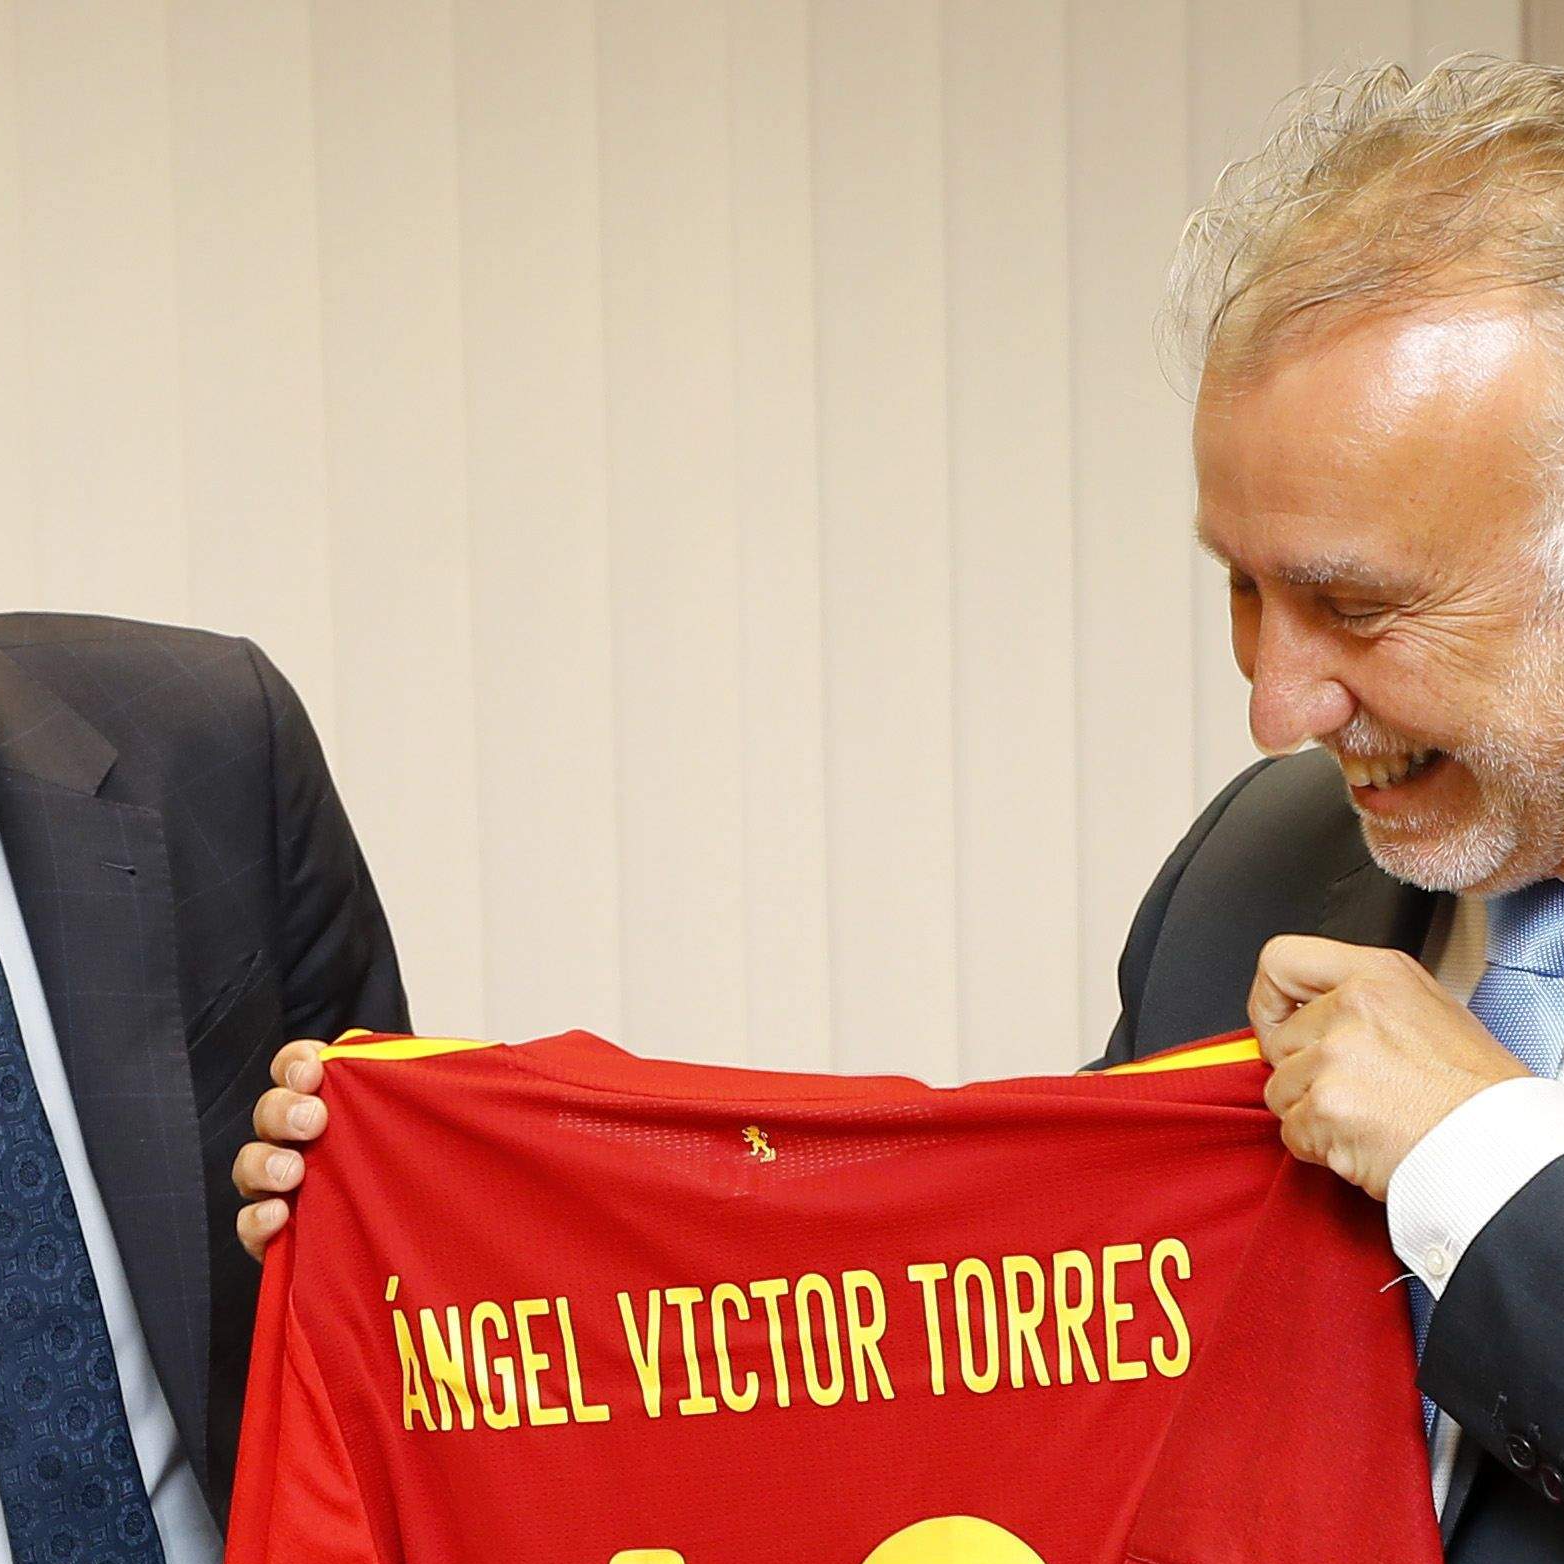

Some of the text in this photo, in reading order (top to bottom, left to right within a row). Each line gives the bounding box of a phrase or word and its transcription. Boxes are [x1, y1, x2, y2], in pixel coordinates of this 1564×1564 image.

[385, 1237, 1192, 1431] ÁNGEL VICTOR TORRES
